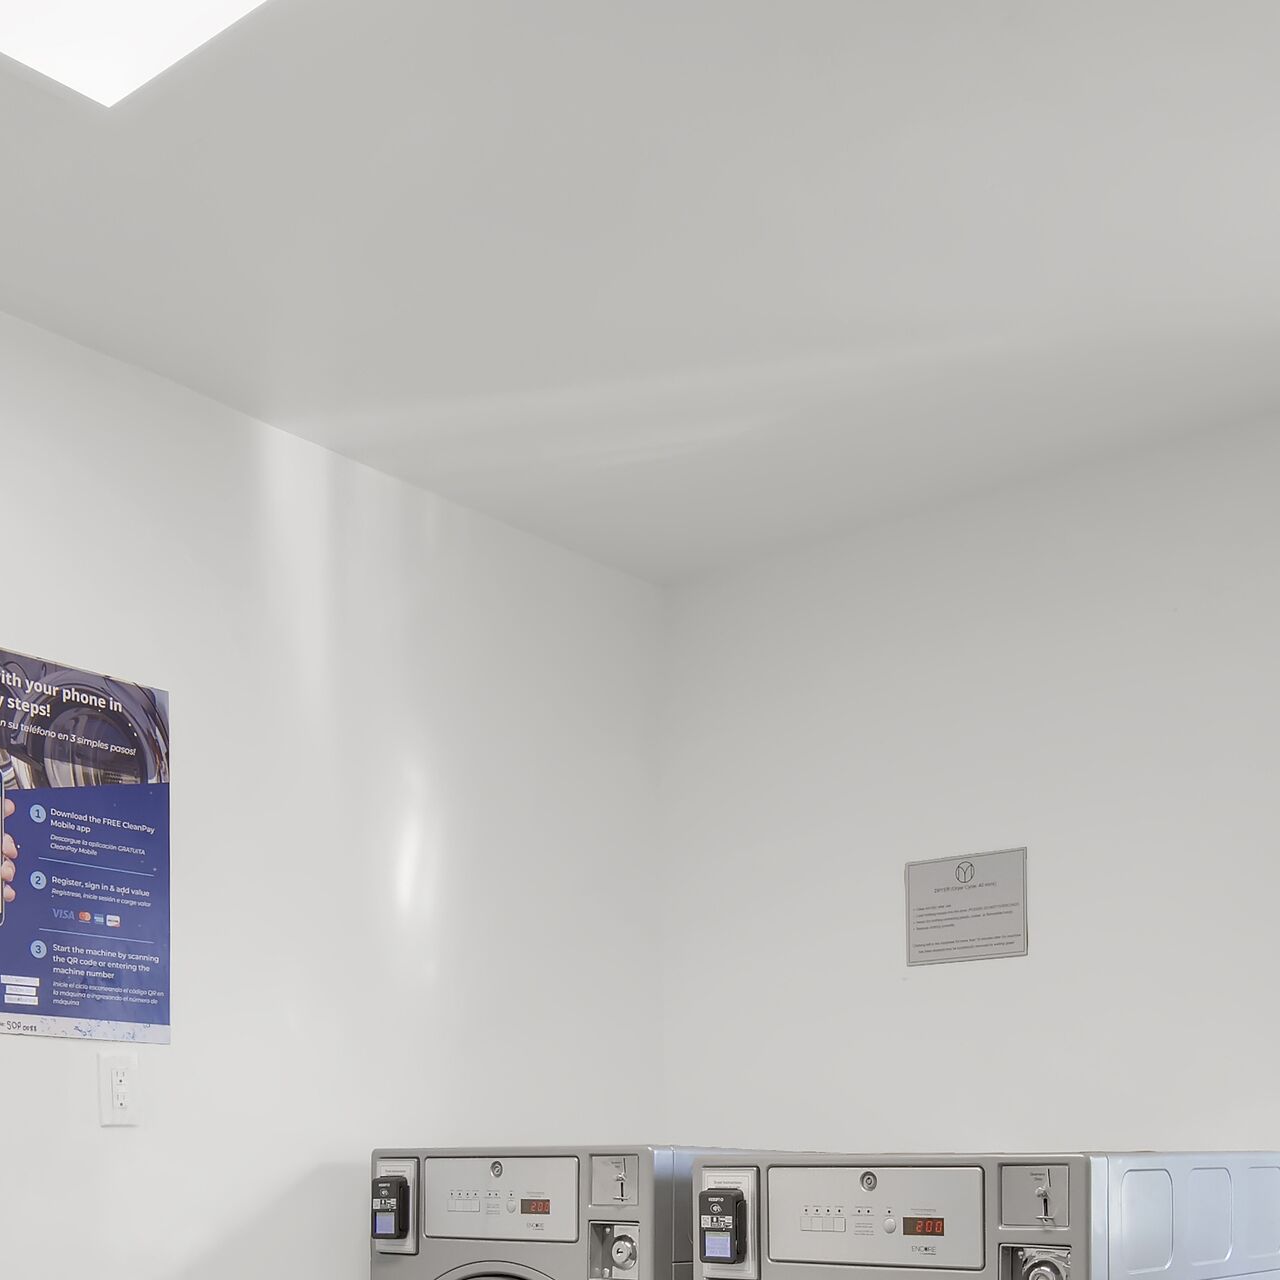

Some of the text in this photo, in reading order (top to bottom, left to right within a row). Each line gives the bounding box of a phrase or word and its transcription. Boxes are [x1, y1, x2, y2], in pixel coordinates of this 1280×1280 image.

[25, 678, 59, 697] your
[62, 687, 106, 708] phone
[109, 697, 122, 712] in
[7, 697, 51, 717] steps!
[8, 721, 19, 729] su
[20, 724, 56, 738] teléfono
[69, 734, 76, 742] 3
[77, 736, 109, 749] simples
[110, 744, 136, 755] pasos!
[35, 809, 41, 819] 1
[50, 808, 156, 835] Download the FREE CleanPay
[50, 819, 91, 834] Mobile app
[50, 834, 81, 845] Descargue
[88, 840, 117, 851] aplicación
[117, 845, 146, 856] GRATUITA
[50, 843, 98, 856] CleanPay Mobile
[35, 875, 41, 885] 2
[51, 876, 150, 897] Register, sign in & add value
[52, 908, 75, 920] VISA
[35, 944, 42, 954] 3
[53, 943, 160, 964] Start the machine by scanning
[53, 955, 66, 963] the
[66, 956, 78, 965] QR
[79, 958, 97, 967] code
[107, 961, 139, 972] entering
[138, 964, 150, 972] the
[53, 967, 115, 979] machine number
[148, 989, 157, 997] QR
